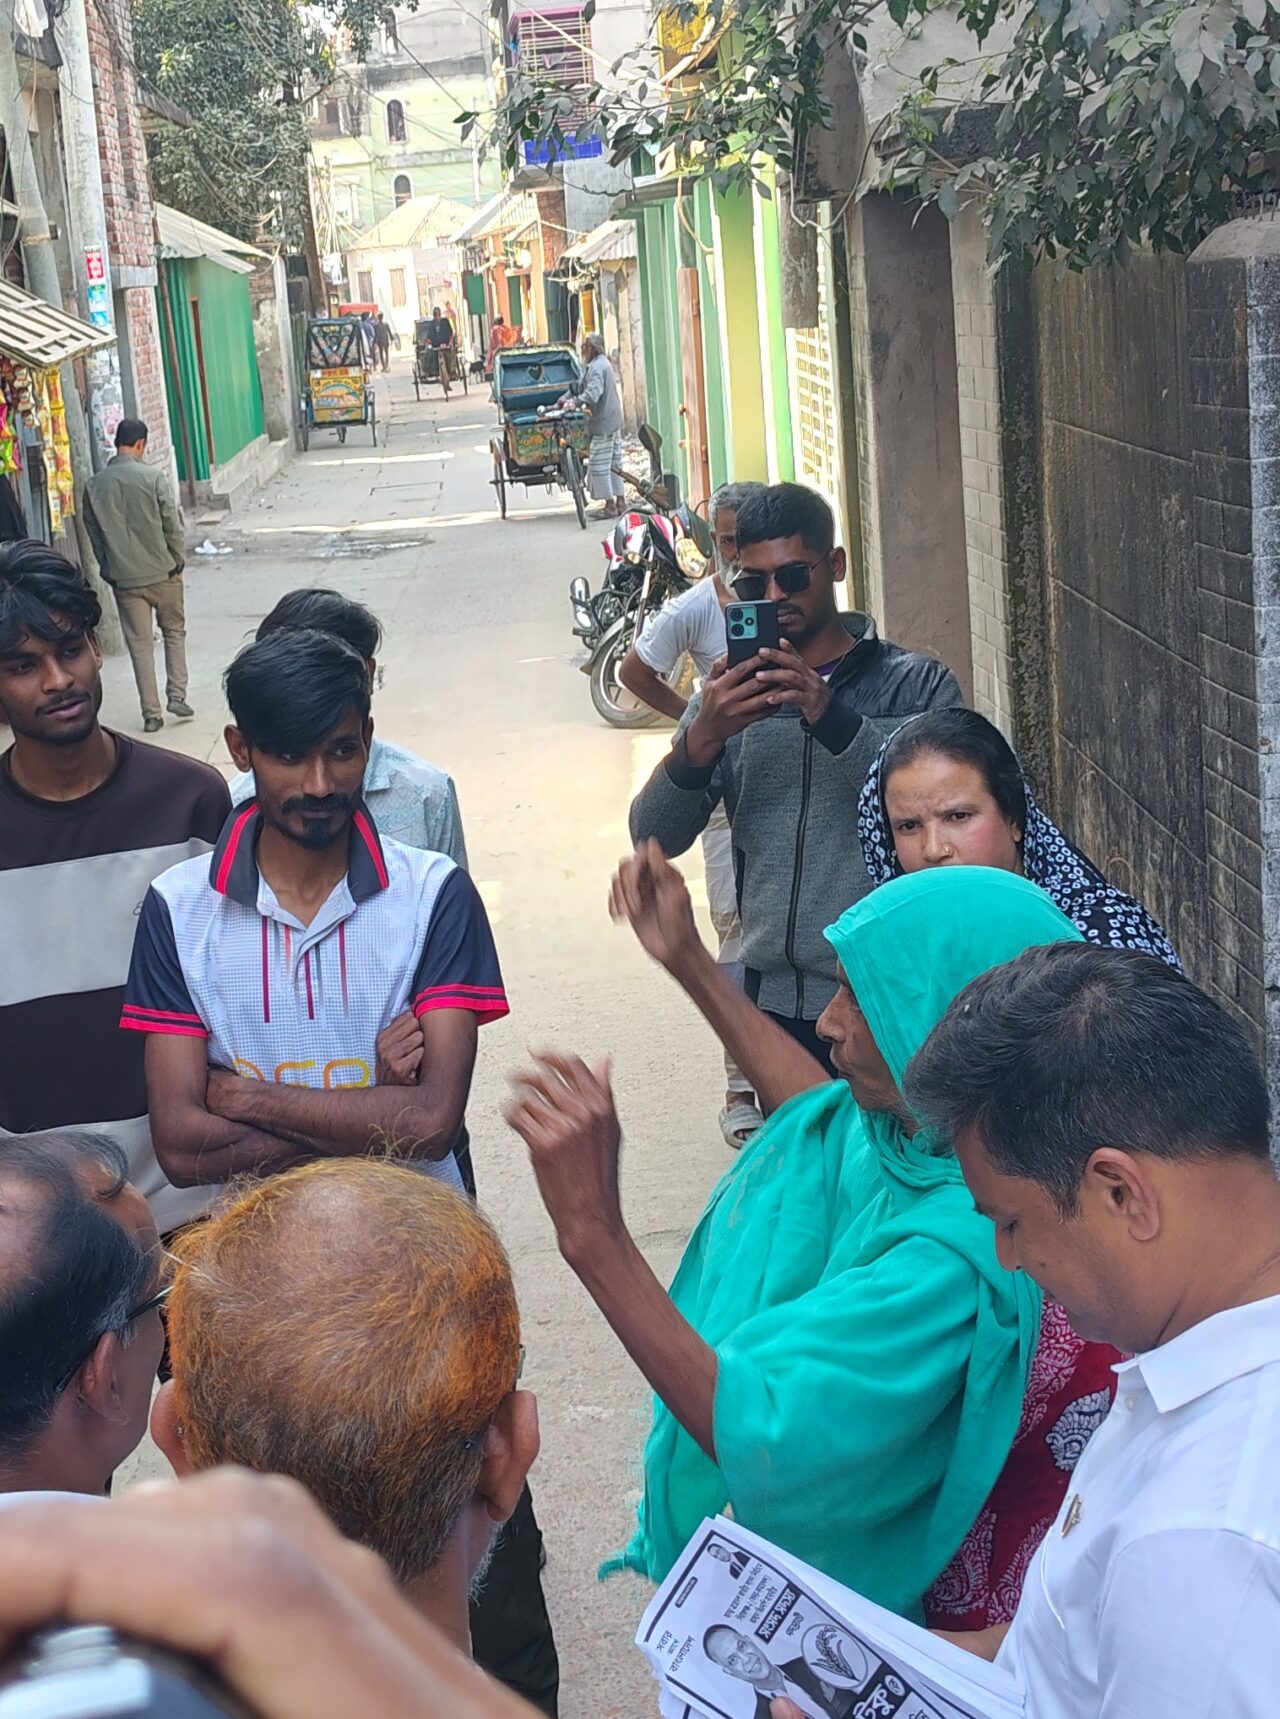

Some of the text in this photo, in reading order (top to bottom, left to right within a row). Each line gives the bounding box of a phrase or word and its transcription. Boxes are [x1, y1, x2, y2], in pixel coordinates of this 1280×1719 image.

[757, 1610, 782, 1639] সংসদ
[656, 1630, 672, 1651] সবার
[669, 1635, 696, 1671] বাংলাদেশ
